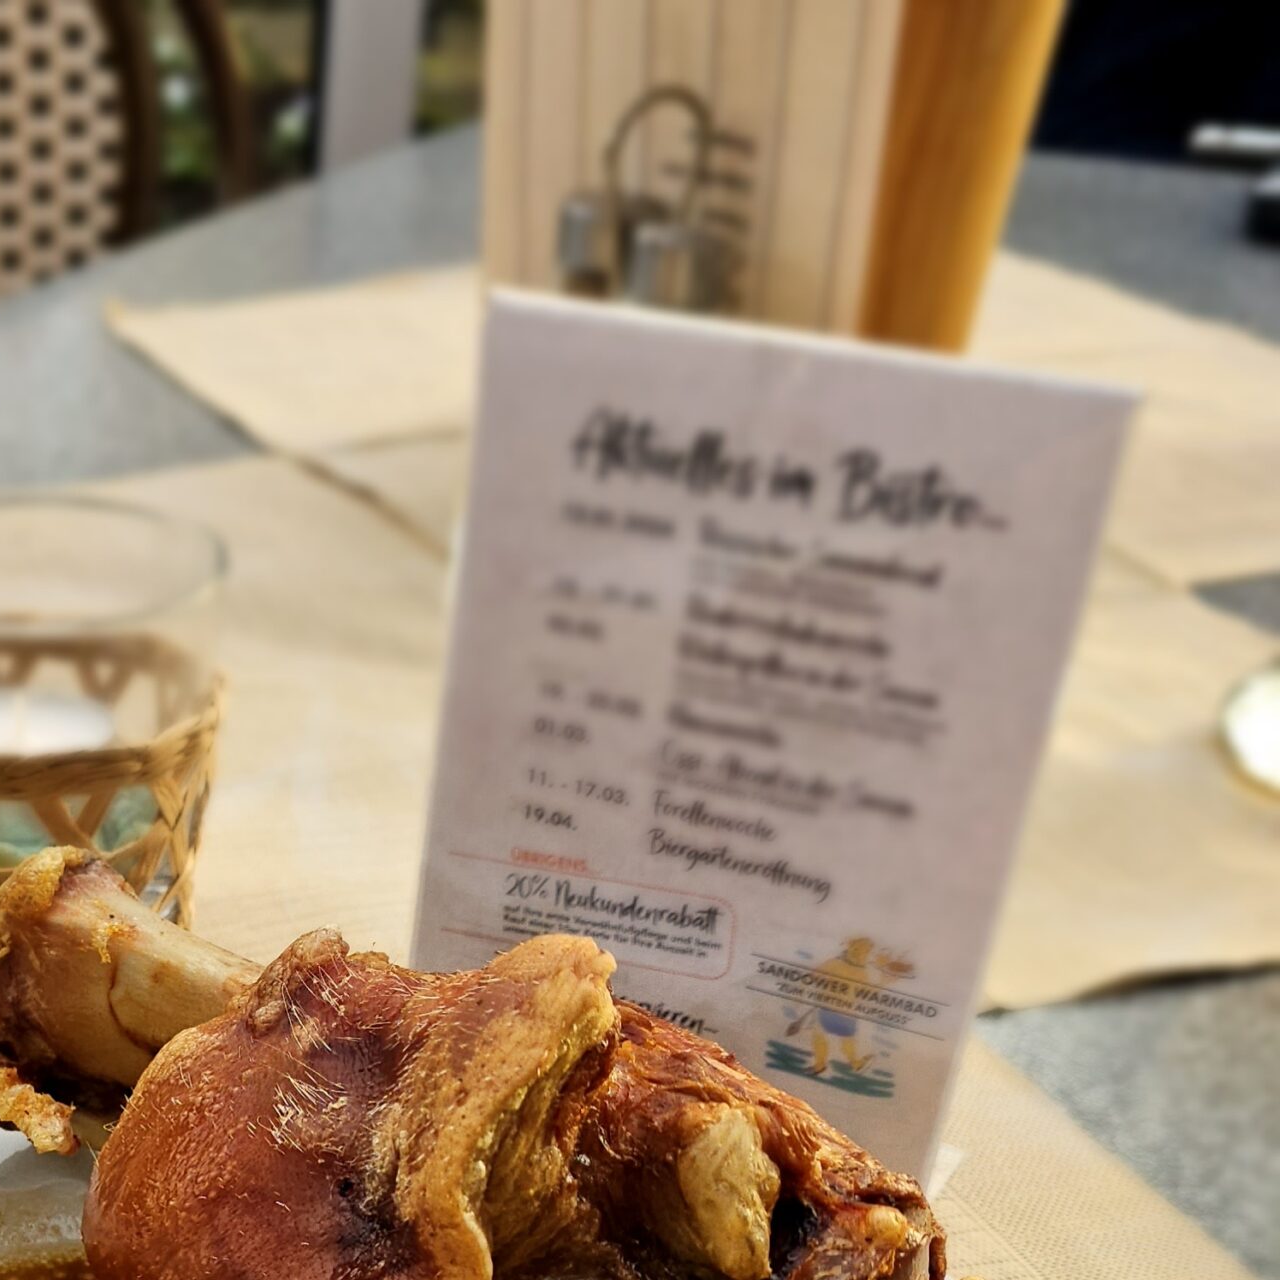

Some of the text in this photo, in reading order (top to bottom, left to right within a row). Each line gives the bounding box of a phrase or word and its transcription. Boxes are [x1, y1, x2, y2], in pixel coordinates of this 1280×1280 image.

[524, 804, 832, 904] 19.04. Biergarteneröffnung
[504, 872, 723, 935] 20% Neukundenrabatt
[755, 961, 939, 1019] SANDOWER WARMBAD
